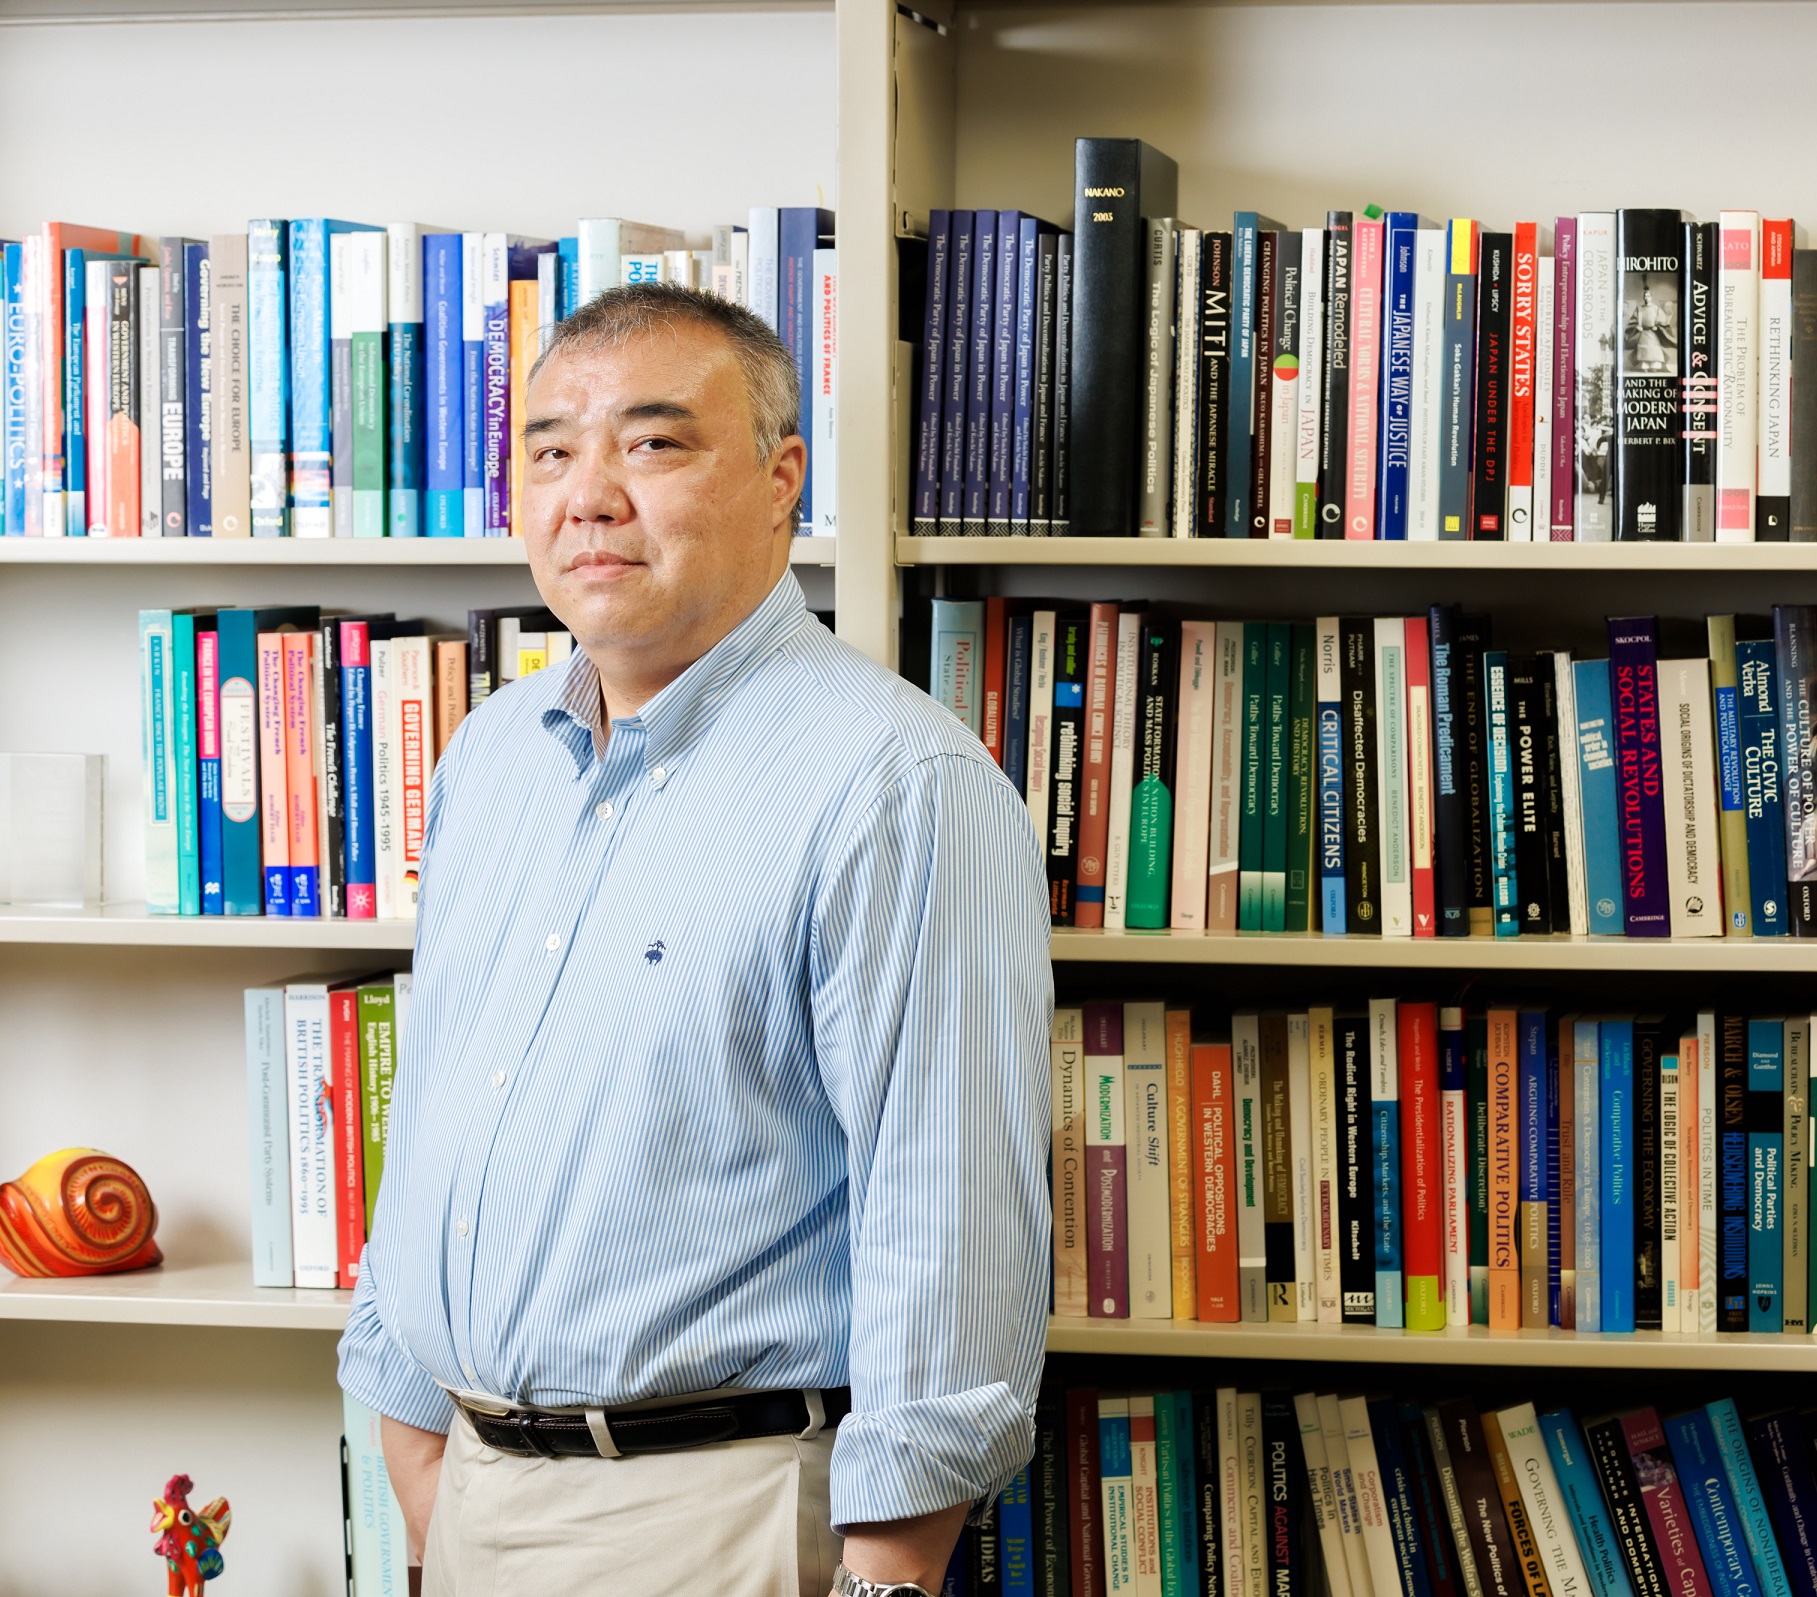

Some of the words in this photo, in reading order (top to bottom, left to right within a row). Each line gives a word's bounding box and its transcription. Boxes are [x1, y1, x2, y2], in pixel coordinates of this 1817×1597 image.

[1084, 188, 1124, 197] NAKANO
[1025, 239, 1033, 255] The
[1153, 230, 1163, 266] CURTIS
[1212, 239, 1220, 285] JOHNSON
[1335, 239, 1346, 287] JAPAN
[1399, 245, 1410, 272] Johnson
[1023, 258, 1033, 306] Democratic
[1516, 253, 1531, 320] SORRY
[1596, 250, 1607, 289] JAPAN
[231, 304, 240, 324] THE
[1152, 281, 1160, 306] The
[1581, 250, 1593, 339] CROSSROADS
[1599, 307, 1607, 321] THE
[1693, 280, 1707, 344] ADVICE
[1019, 309, 1033, 331] Party
[1021, 333, 1032, 343] of
[1150, 310, 1159, 348] Logic
[1204, 290, 1226, 356] MITI
[1332, 293, 1348, 367] Remodeled
[231, 329, 240, 374] CHOICE
[823, 343, 830, 354] OF
[1018, 344, 1032, 367] Japan
[1150, 351, 1160, 367] of
[1392, 310, 1411, 373] JAPANESE
[1488, 333, 1498, 373] JAPAN
[1514, 325, 1530, 396] STATES
[1691, 351, 1707, 367] &
[1769, 317, 1779, 408] RETHINKING
[488, 320, 505, 418] DEMOCRACY
[1020, 369, 1031, 377] in
[1210, 359, 1219, 379] AND
[1305, 337, 1314, 390] DEMOCRACY
[1625, 379, 1646, 388] AND
[1649, 379, 1667, 388] THE
[9, 302, 24, 469] EURO-POLITICS
[231, 379, 240, 403] FOR
[1019, 380, 1031, 406] Power
[1146, 370, 1159, 437] Japanese
[1209, 381, 1217, 399] THE
[1305, 394, 1311, 403] IN
[1390, 376, 1409, 405] WAY
[1487, 380, 1496, 422] UNDER
[490, 418, 503, 430] in
[1208, 404, 1216, 446] JAPANESE
[1396, 405, 1403, 415] OF
[1617, 402, 1677, 414] MODERN
[1627, 417, 1667, 432] JAPAN
[162, 402, 183, 480] EUROPE
[231, 407, 240, 452] EUROPE
[1300, 409, 1314, 459] JAPAN
[1388, 416, 1408, 467] JUSTICE
[1486, 430, 1496, 451] THE
[1768, 414, 1779, 457] JAPAN
[487, 431, 503, 477] Europe
[1147, 441, 1157, 493] Politics
[1207, 451, 1215, 490] MIRACLE
[1485, 459, 1494, 480] DPJ
[378, 651, 386, 677] Pulzer
[1323, 635, 1335, 673] Norris
[1436, 643, 1450, 666] The
[1437, 668, 1452, 711] Roman
[1741, 660, 1756, 696] Verba
[1755, 661, 1772, 711] Almond
[378, 690, 387, 741] German
[985, 691, 997, 747] GLOBALIZATION
[1353, 691, 1364, 758] Disaffected
[1617, 666, 1636, 742] SOCIAL
[1637, 665, 1655, 742] STATES
[239, 704, 252, 795] FESTIVALS
[378, 742, 388, 784] Politics
[404, 703, 420, 785] GOVERNING
[1054, 721, 1077, 780] rethinking
[1322, 710, 1338, 786] CRITICAL
[1438, 714, 1455, 794] Predicament
[1519, 725, 1533, 784] POWER
[1761, 728, 1775, 758] THE
[1641, 748, 1658, 795] AND
[1745, 746, 1764, 818] CULTURE
[1761, 761, 1778, 802] CIVIC
[1056, 782, 1074, 814] social
[1355, 762, 1366, 842] Democracies
[1522, 792, 1535, 831] ELITE
[405, 789, 421, 859] GERMANY
[1051, 817, 1073, 855] inquiry
[1323, 791, 1340, 868] CITIZENS
[1622, 749, 1644, 897] REVOLUTIONS
[364, 995, 389, 1004] Lloyd
[296, 1019, 307, 1080] BRITISH
[312, 1019, 322, 1050] THE
[379, 1022, 391, 1075] EMPIRE
[1345, 1031, 1354, 1047] The
[1211, 1071, 1220, 1098] DAHL
[1346, 1050, 1356, 1084] Radical
[380, 1078, 391, 1100] TO
[1059, 1051, 1075, 1131] Dynamics
[1146, 1083, 1158, 1131] Culture
[1344, 1087, 1356, 1111] Right
[1664, 1091, 1675, 1106] THE
[297, 1084, 309, 1153] POLITICS
[313, 1055, 327, 1193] TRANSFORMATION
[1203, 1108, 1214, 1119] IN
[1212, 1107, 1222, 1159] POLITICAL
[1347, 1114, 1357, 1123] in
[1495, 1062, 1509, 1183] COMPARATIVE
[1664, 1110, 1675, 1136] LOGIC
[1063, 1137, 1077, 1151] of
[1103, 1150, 1112, 1162] and
[1145, 1136, 1159, 1165] Shift
[1203, 1122, 1215, 1172] WESTERN
[1347, 1126, 1357, 1163] Western
[1444, 1101, 1455, 1183] RATIONALIZING
[1663, 1140, 1675, 1149] OF
[1702, 1108, 1711, 1162] POLITICS
[1664, 1153, 1676, 1203] COLLECTIVE
[1702, 1167, 1711, 1178] IN
[1754, 1147, 1767, 1168] and
[1766, 1148, 1776, 1189] Political
[1063, 1157, 1077, 1248] Contention
[1214, 1164, 1224, 1234] OPPOSITIONS
[1347, 1166, 1358, 1197] Europe
[1702, 1182, 1711, 1210] TIME
[1752, 1171, 1767, 1231] Democracy
[317, 1197, 327, 1216] OF
[1204, 1176, 1217, 1251] DEMOCRACIES
[1446, 1187, 1456, 1253] PARLIAMENT
[1664, 1208, 1676, 1240] ACTION
[1766, 1193, 1776, 1228] Parties
[1496, 1191, 1509, 1267] POLITICS
[1271, 1442, 1287, 1500] POLITICS
[1108, 1486, 1120, 1551] INSTITUTIONAL
[1117, 1485, 1125, 1531] EMPIRICAL
[1122, 1574, 1128, 1583] IN
[1274, 1506, 1289, 1564] AGAINST
[1508, 1500, 1534, 1557] FORCES
[1526, 1561, 1541, 1579] OF
[1655, 1487, 1686, 1556] Varieties
[1704, 1478, 1744, 1581] Contemporary
[980, 1536, 995, 1582] IDEAS
[1111, 1554, 1119, 1590] CHANGE
